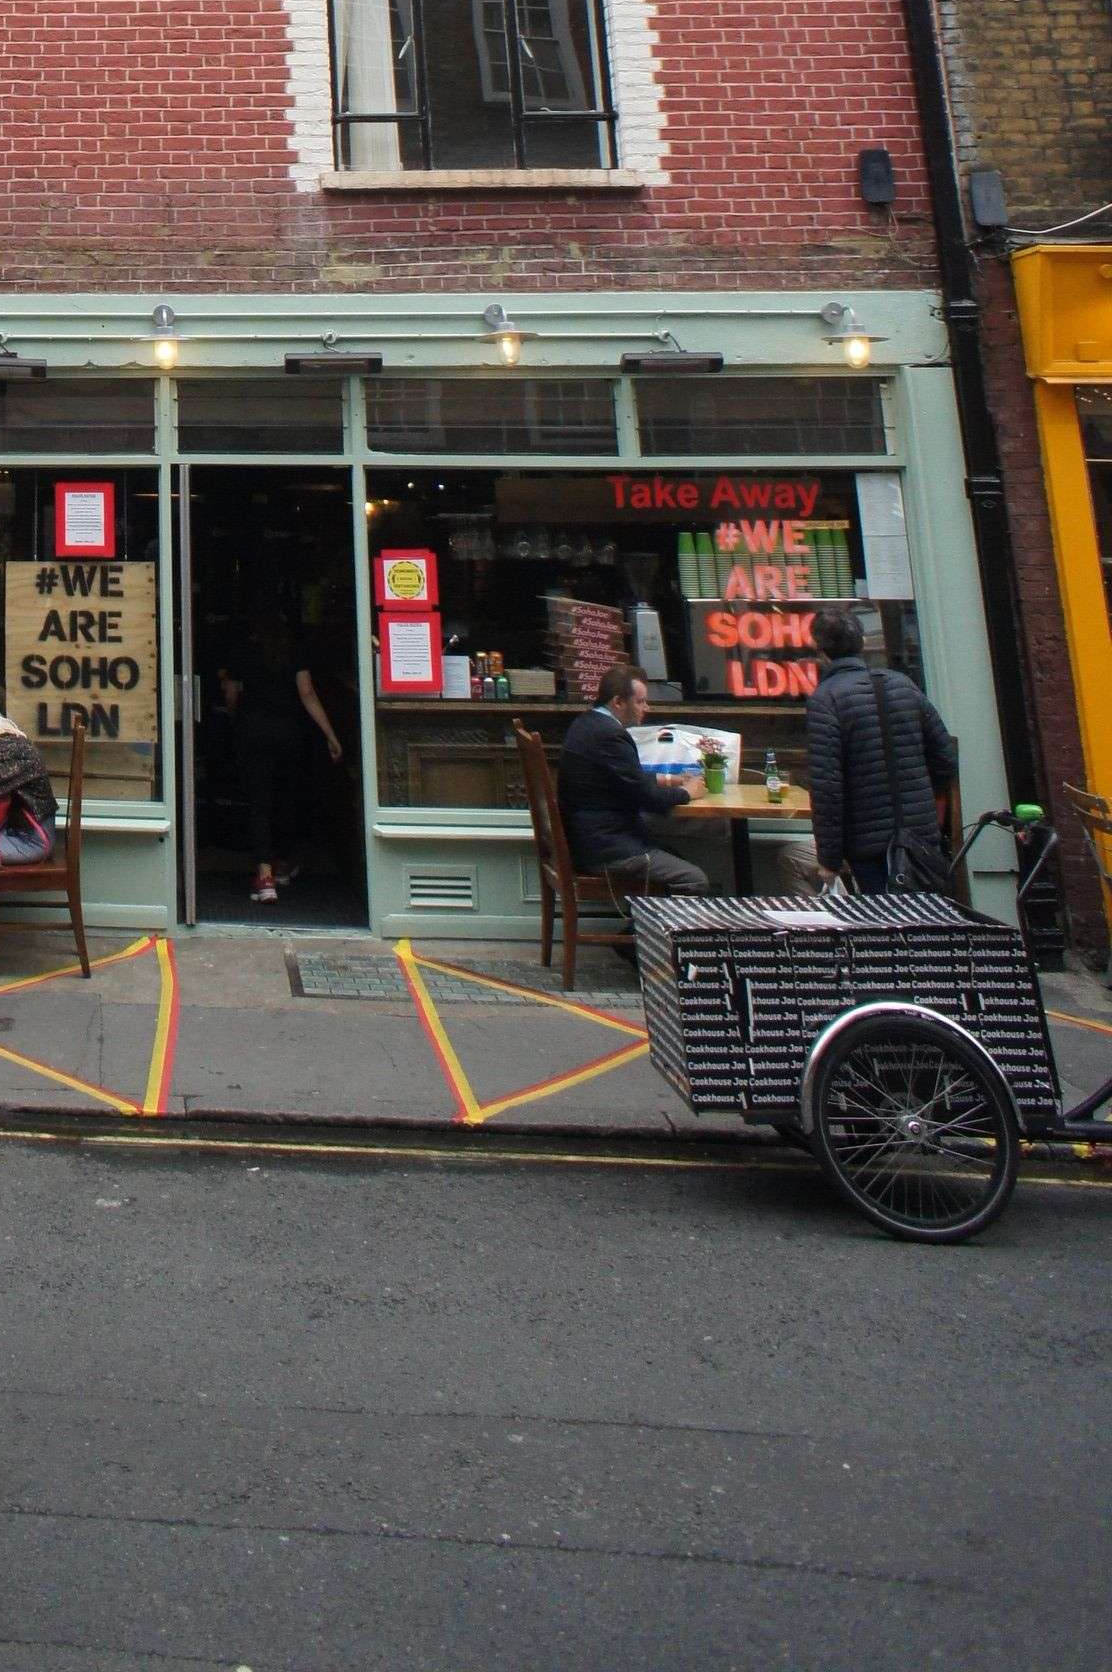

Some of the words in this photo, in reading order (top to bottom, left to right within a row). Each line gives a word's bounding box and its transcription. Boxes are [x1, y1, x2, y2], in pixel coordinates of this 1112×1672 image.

[607, 475, 699, 509] Take
[711, 476, 820, 516] Away
[716, 519, 810, 554] #WE
[35, 564, 124, 598] #WE
[724, 565, 815, 602] ARE
[38, 609, 123, 643] ARE
[20, 653, 140, 691] SOHO
[728, 660, 818, 698] LDN
[37, 701, 120, 739] LDN
[908, 934, 950, 942] Cookhouse
[951, 933, 966, 941] Joe
[733, 950, 776, 958] Cookhouse
[894, 949, 909, 957] Joe
[909, 949, 951, 958] Cookhouse
[952, 948, 967, 957] Joe
[1011, 949, 1027, 958] Joe
[777, 965, 792, 974] Joe
[894, 965, 909, 973] Joe
[909, 965, 952, 973] Cookhouse
[953, 964, 968, 973] Joe
[1014, 965, 1029, 973] Joe
[678, 981, 720, 989] Cookhouse
[779, 980, 794, 989] Joe
[794, 981, 837, 989] Cookhouse
[853, 981, 895, 989] Cookhouse
[895, 980, 911, 989] Joe
[911, 980, 955, 989] Cookhouse
[956, 980, 971, 989] Joe
[971, 980, 1015, 989] Cookhouse
[1016, 980, 1032, 989] Joe
[679, 997, 721, 1005] Cookhouse
[781, 996, 796, 1005] Joe
[796, 997, 840, 1006] Cookhouse
[840, 997, 856, 1006] Joe
[913, 995, 958, 1004] Cookhouse
[1019, 997, 1036, 1005] Joe
[681, 1013, 723, 1021] Cookhouse
[782, 1011, 798, 1021] Joe
[961, 1013, 977, 1021] Joe
[978, 1013, 1022, 1022] Cookhouse
[1023, 1014, 1040, 1023] Joe
[683, 1028, 725, 1037] Cookhouse
[785, 1028, 801, 1037] Joe
[980, 1029, 1025, 1039] Cookhouse
[1026, 1030, 1043, 1039] Joe
[685, 1045, 728, 1053] Cookhouse
[728, 1045, 744, 1053] Joe
[745, 1044, 788, 1053] Cookhouse
[788, 1044, 803, 1053] Joe
[988, 1046, 1027, 1056] ookhouse
[1027, 1047, 1045, 1057] Joe
[688, 1061, 730, 1070] Cookhouse
[731, 1061, 746, 1070] Joe
[1031, 1064, 1048, 1073] Joe
[689, 1077, 732, 1086] Cookhouse
[732, 1077, 748, 1086] Joe
[749, 1077, 792, 1086] Cookhouse
[692, 1093, 735, 1102] Cookhouse
[752, 1094, 795, 1103] Cookhouse
[1037, 1096, 1053, 1105] Joe
